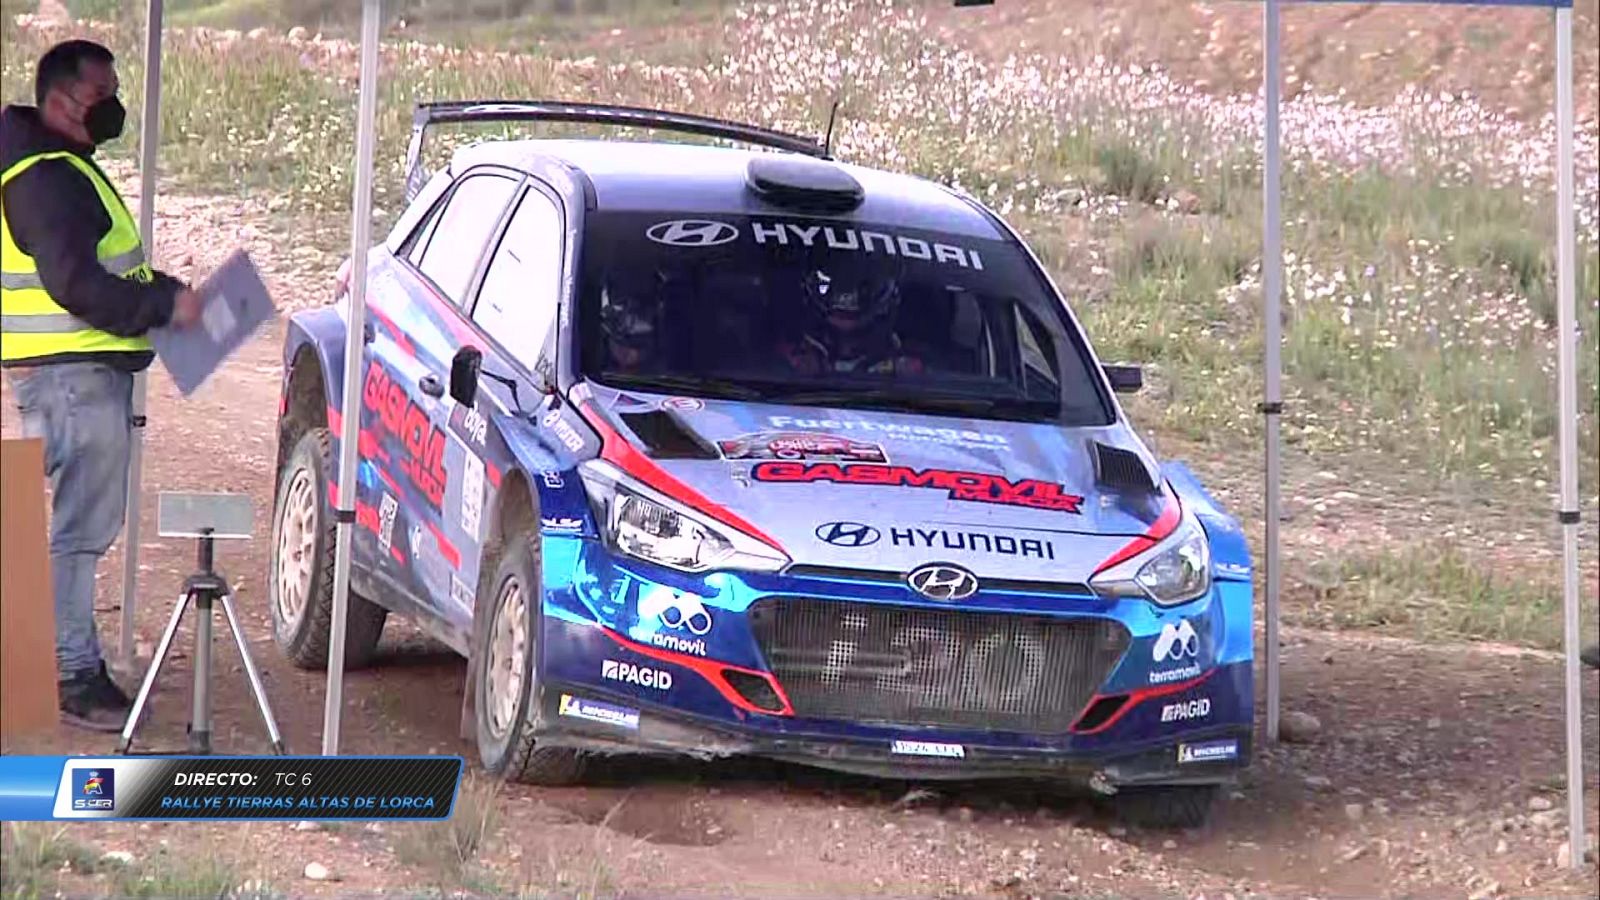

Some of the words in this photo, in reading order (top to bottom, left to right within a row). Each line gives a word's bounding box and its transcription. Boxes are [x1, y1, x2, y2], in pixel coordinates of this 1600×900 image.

[752, 222, 983, 271] HYUNDAI
[767, 415, 1007, 444] Fuertwagen
[751, 461, 1085, 504] GASMOVIL
[890, 527, 1055, 560] HYUNDAI
[618, 664, 672, 690] PAGID
[1173, 698, 1210, 721] PAGID
